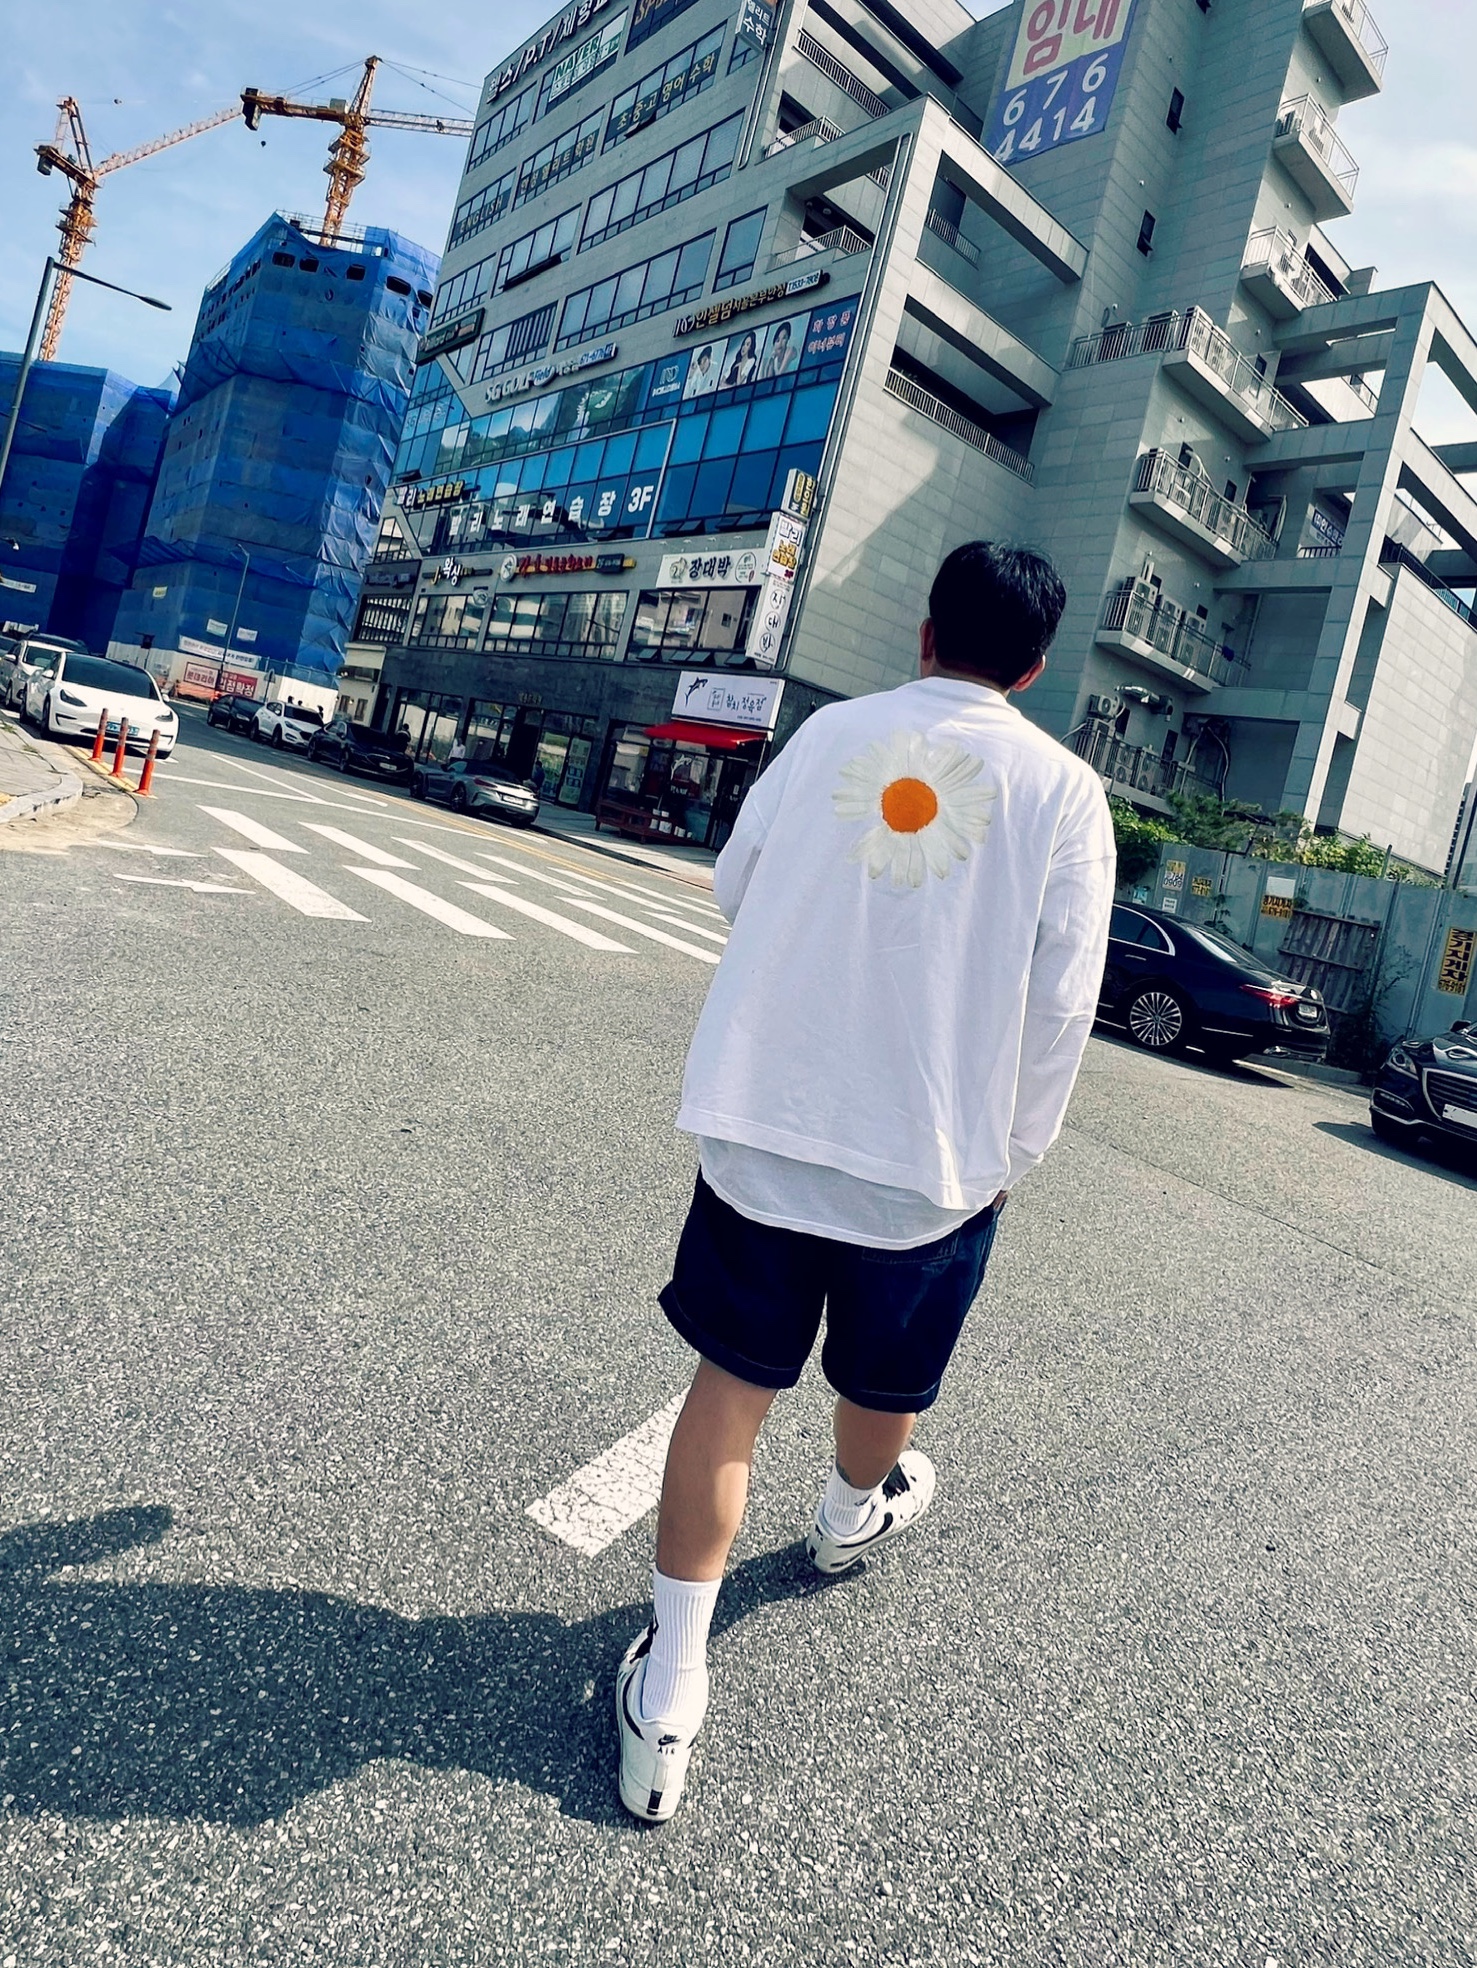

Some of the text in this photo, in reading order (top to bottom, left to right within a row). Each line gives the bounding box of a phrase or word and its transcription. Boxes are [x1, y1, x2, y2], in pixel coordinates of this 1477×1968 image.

[743, 16, 767, 45] 수학
[1023, 0, 1121, 76] 임대
[555, 32, 601, 80] NAVER
[662, 72, 686, 102] 영어
[689, 53, 716, 83] 수학
[1002, 53, 1109, 126] 676
[574, 131, 596, 157] 학원
[994, 96, 1097, 161] 4414
[460, 194, 504, 233] ENGLISH
[695, 300, 733, 329] 인셀덤
[485, 382, 501, 403] SG
[627, 485, 655, 513] 3F
[689, 555, 732, 581] 장대박
[1441, 928, 1474, 981] 경기지게차
